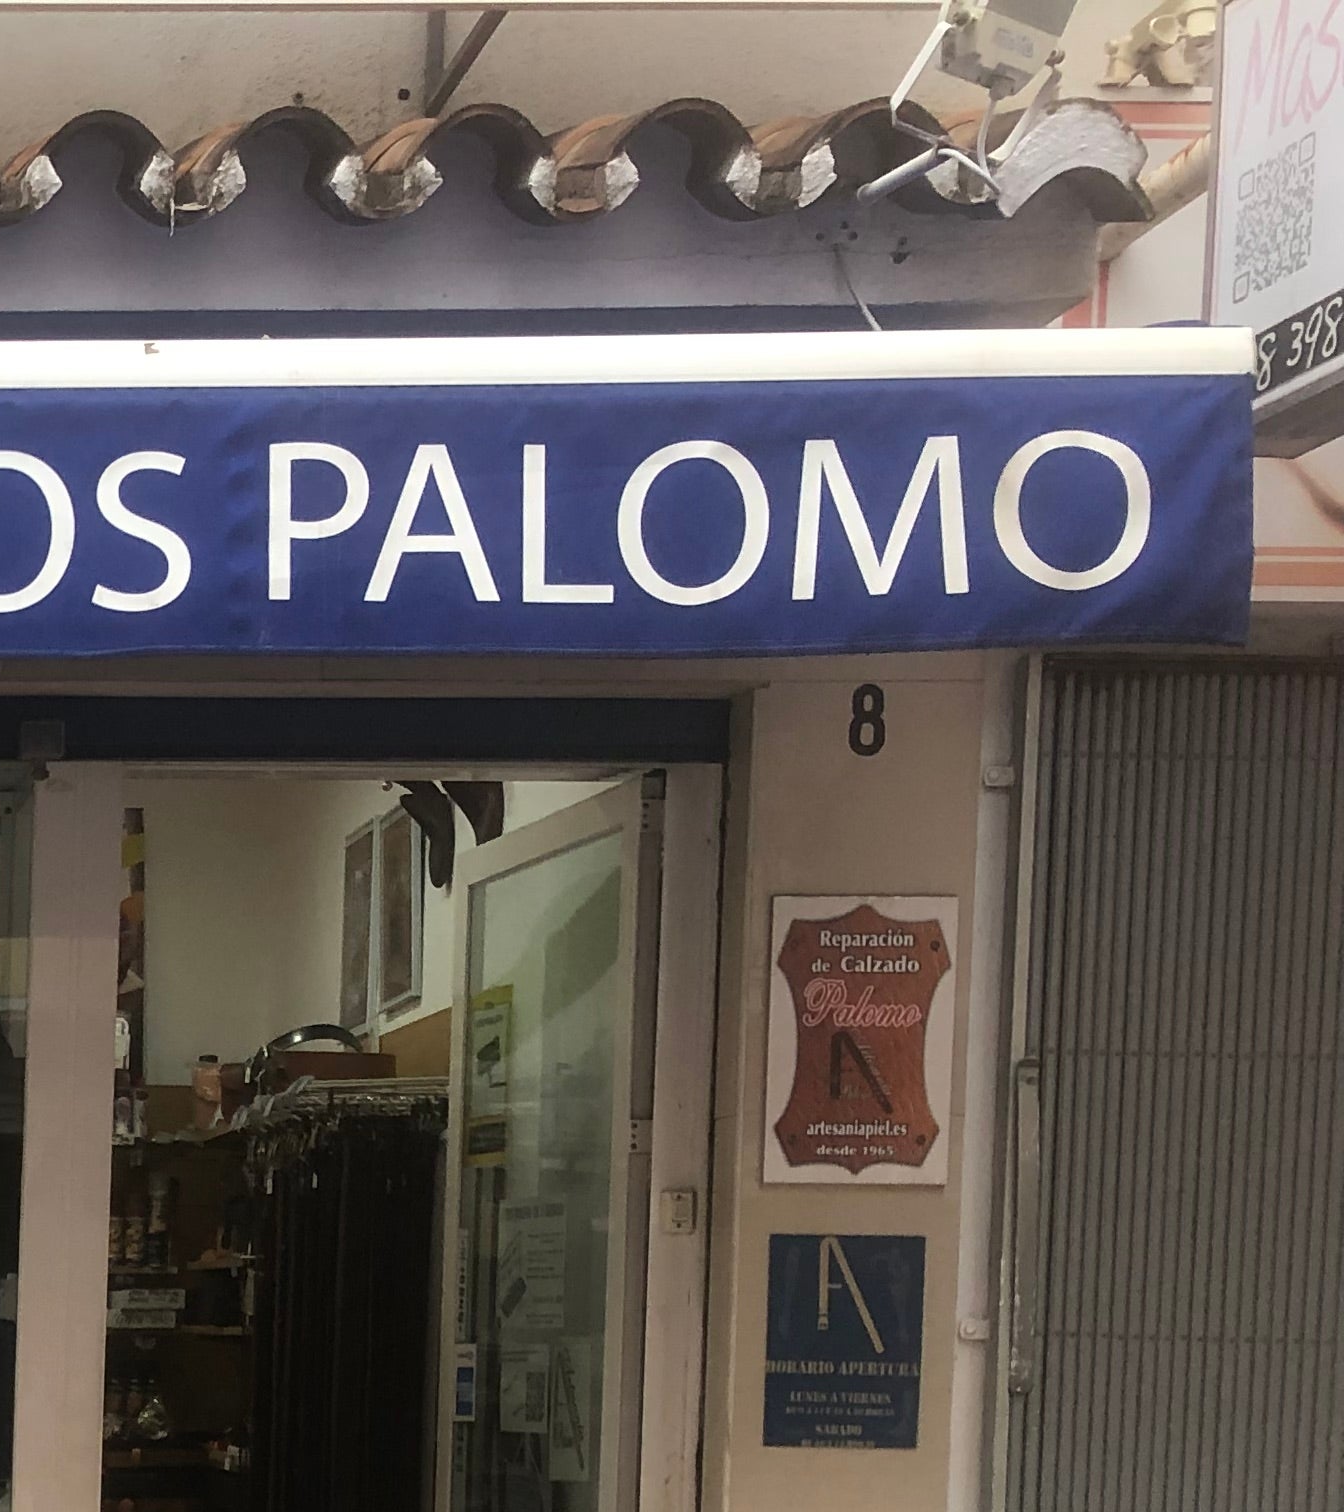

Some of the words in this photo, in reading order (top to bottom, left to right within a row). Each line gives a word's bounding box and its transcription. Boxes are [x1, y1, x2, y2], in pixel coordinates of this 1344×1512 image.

[1286, 296, 1344, 369] 398
[269, 430, 1151, 605] PALOMO
[849, 684, 885, 755] 8
[820, 929, 914, 952] Reparación
[811, 958, 831, 973] de
[840, 955, 920, 973] Calzado
[802, 977, 922, 1028] Palomo
[806, 1120, 907, 1140] artesaniapiel.es
[816, 1145, 857, 1156] desde
[863, 1145, 895, 1156] 1965
